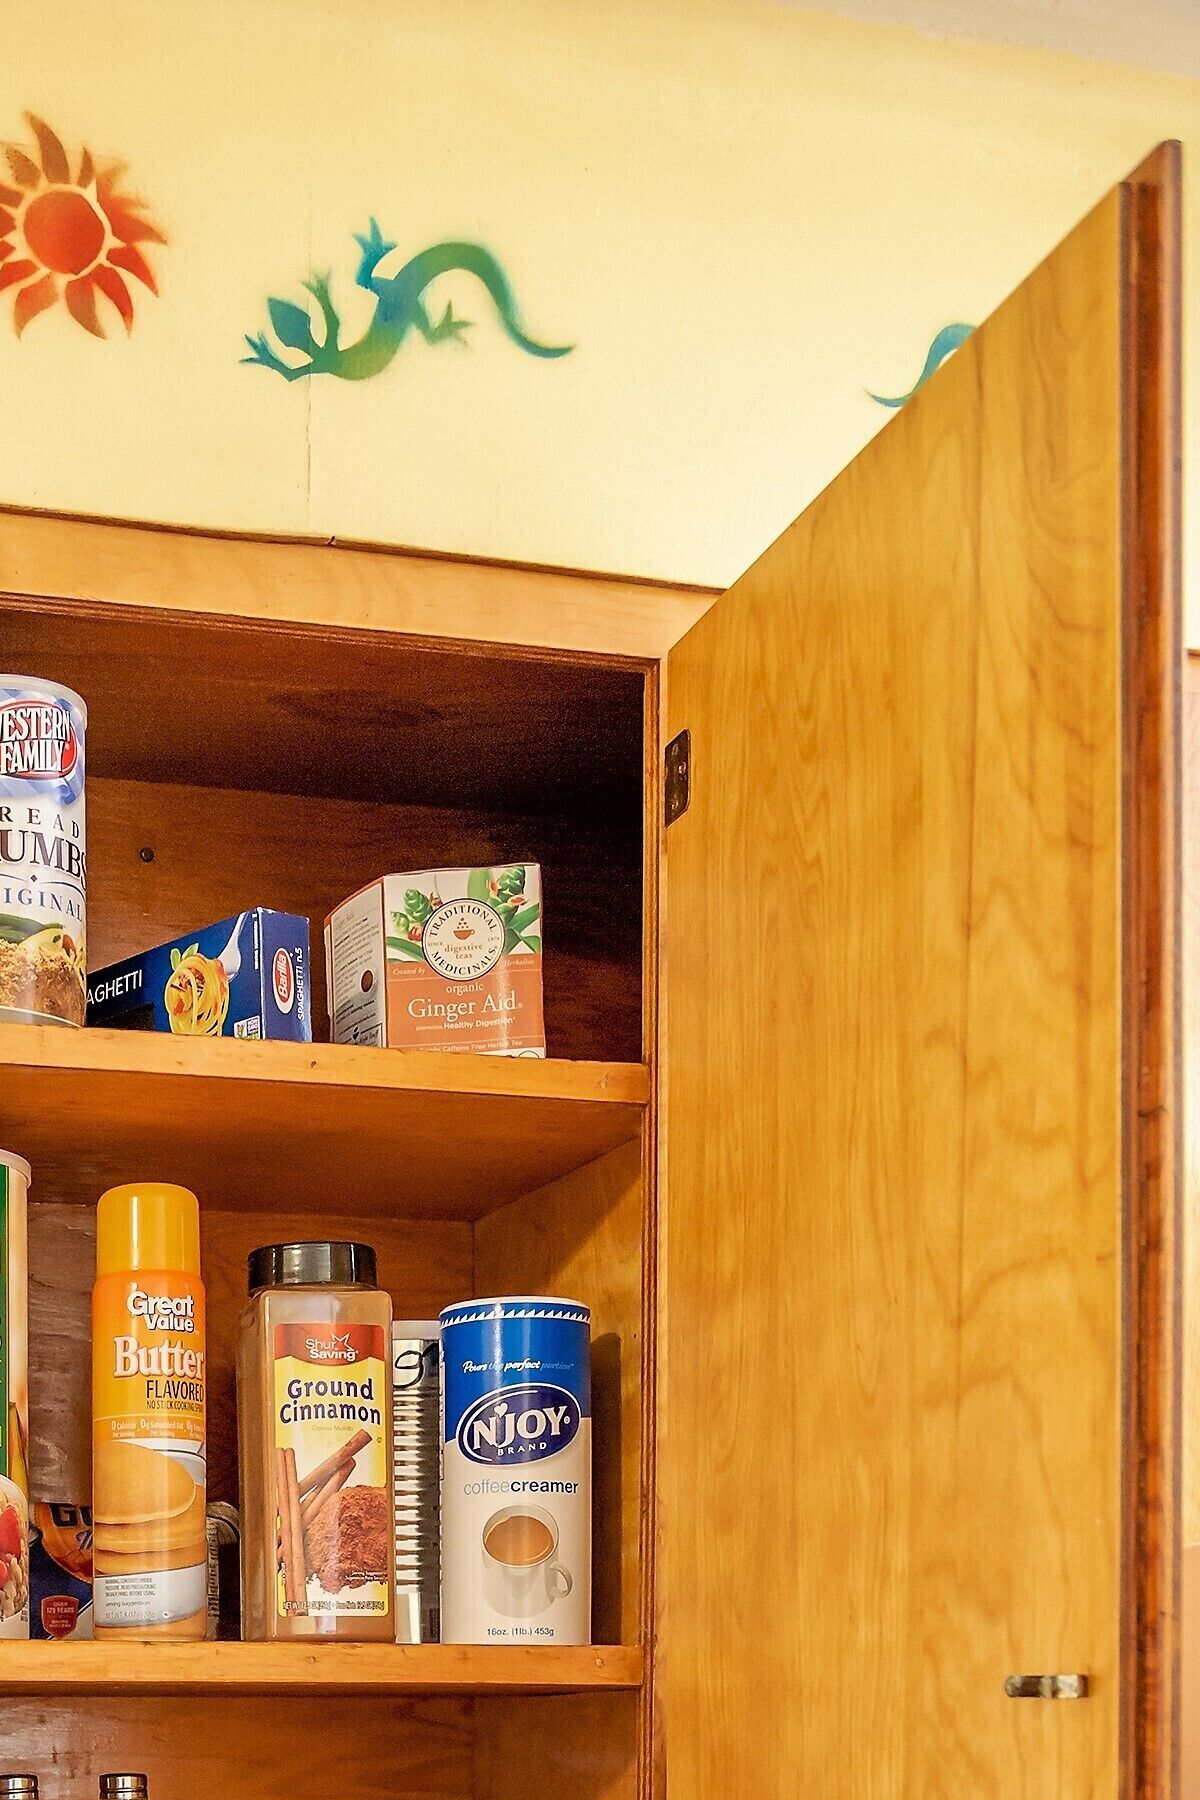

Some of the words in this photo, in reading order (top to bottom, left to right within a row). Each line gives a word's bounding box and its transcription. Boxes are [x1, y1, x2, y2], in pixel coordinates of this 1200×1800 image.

[0, 740, 68, 776] FAMILY
[429, 904, 498, 938] TRADITIONAL
[444, 943, 484, 954] digestive
[455, 952, 473, 960] teas
[431, 948, 497, 976] MEDICINALS
[277, 953, 289, 998] Barilla
[87, 968, 144, 1007] AGHETTI
[295, 965, 305, 1020] SPAGHETTI
[445, 981, 485, 997] organic
[407, 997, 477, 1022] Ginger
[444, 1021, 474, 1030] Healthy
[127, 1290, 194, 1317] Great
[144, 1313, 194, 1333] Value
[305, 1338, 335, 1350] Shur
[309, 1349, 356, 1362] Saving
[113, 1335, 204, 1380] Butter
[462, 1360, 487, 1373] Pours
[504, 1357, 541, 1372] perfect
[287, 1378, 374, 1401] Ground
[280, 1400, 381, 1425] Cinnamon
[497, 1442, 547, 1456] BRAND
[534, 1628, 555, 1637] 453g
